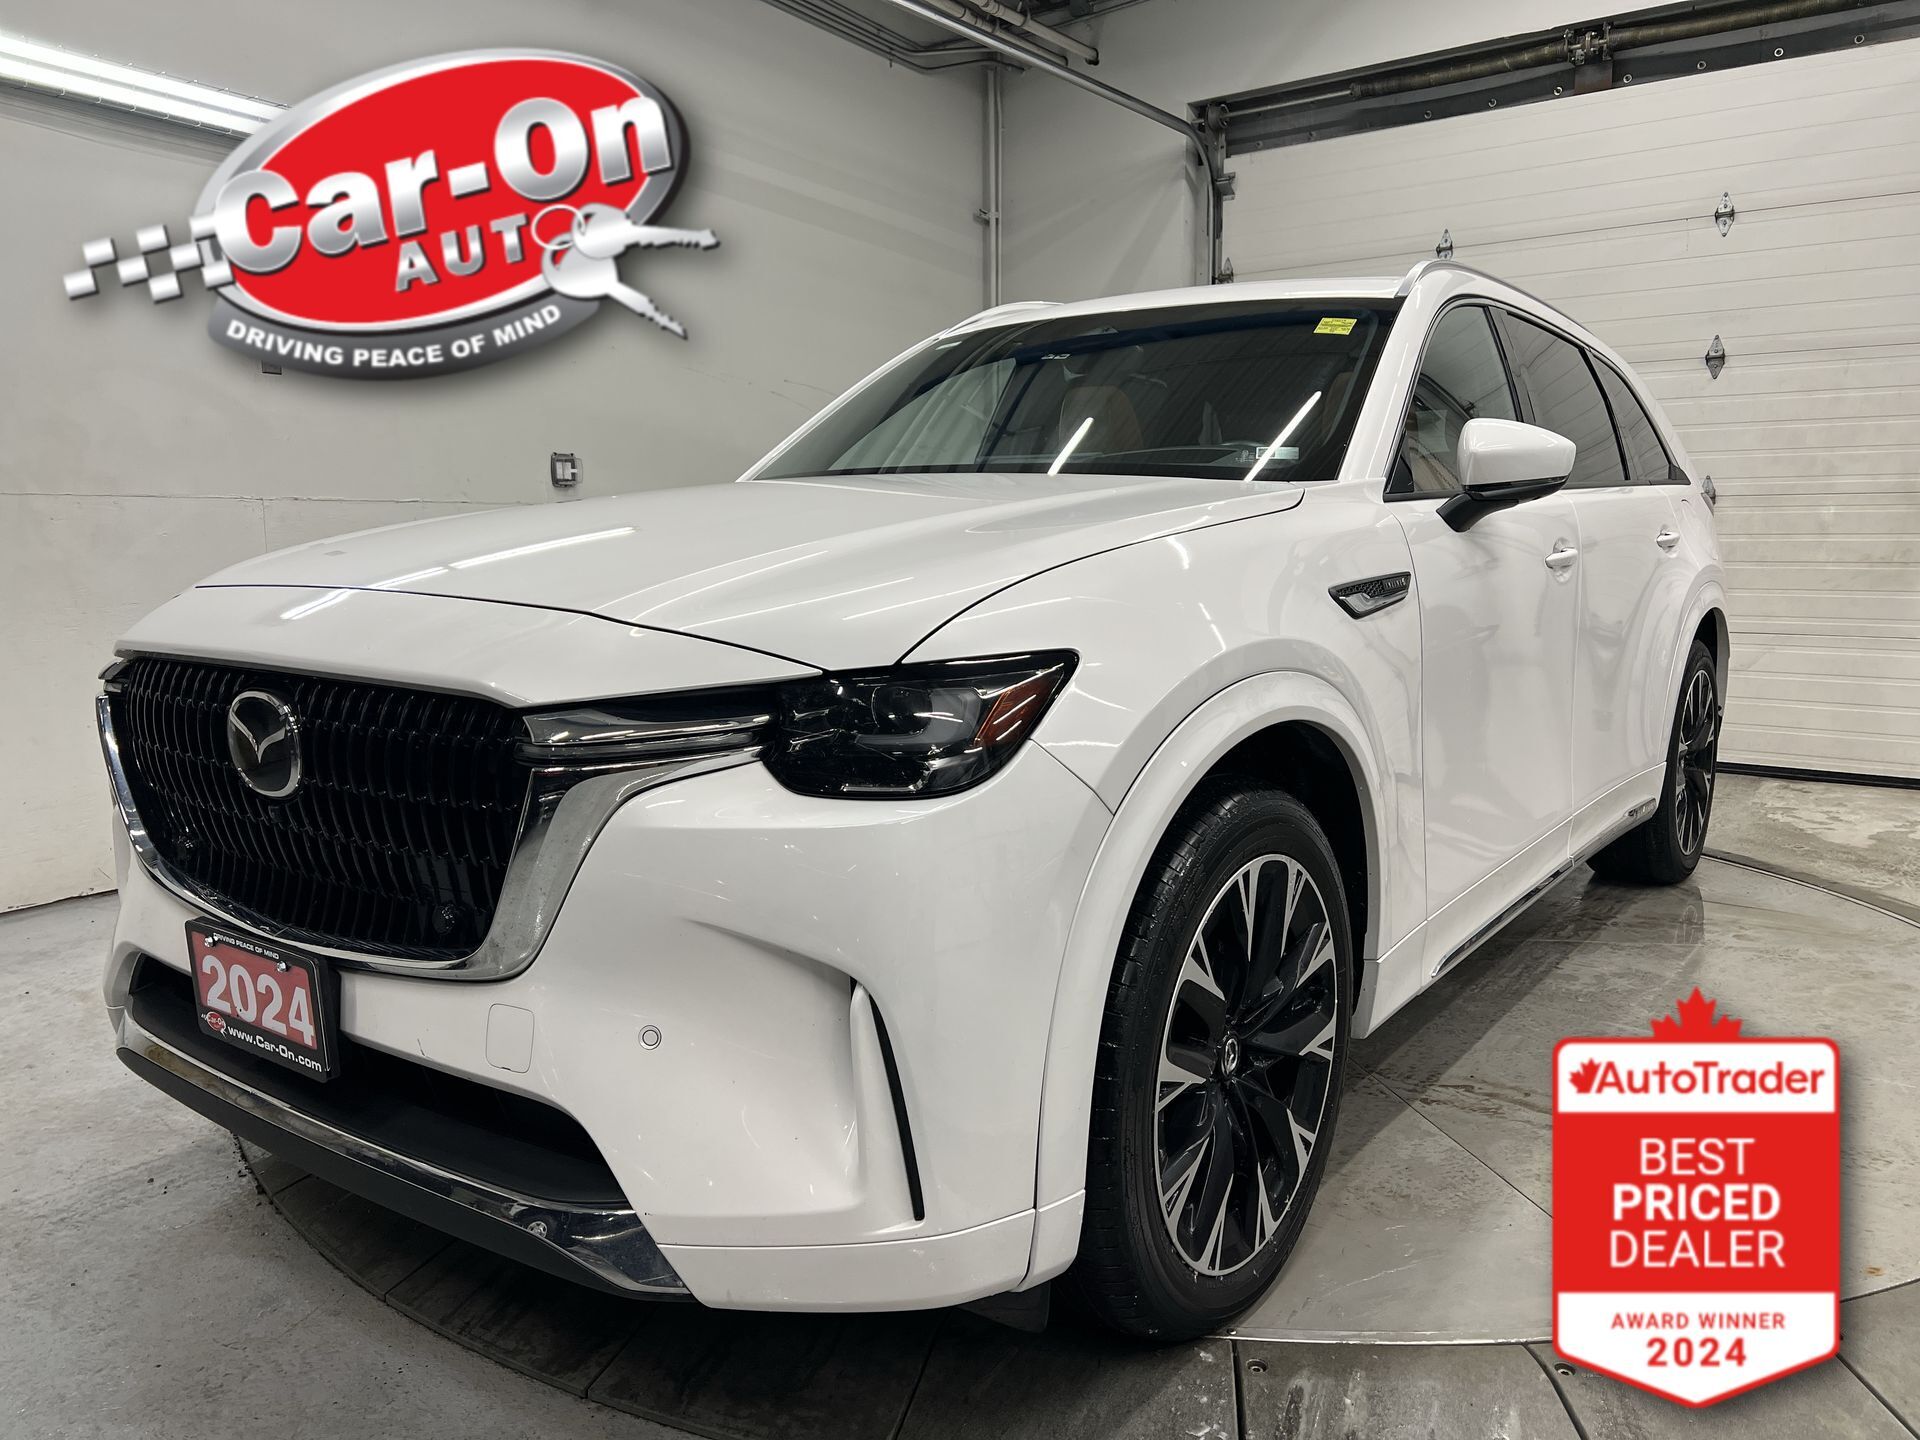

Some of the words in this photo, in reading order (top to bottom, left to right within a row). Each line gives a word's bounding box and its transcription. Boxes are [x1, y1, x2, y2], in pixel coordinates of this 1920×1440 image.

[236, 940, 255, 952] PEACE
[255, 946, 263, 954] OF
[264, 949, 280, 960] MIND
[202, 954, 315, 1047] 2024
[227, 1026, 323, 1073] www.Car-On.com
